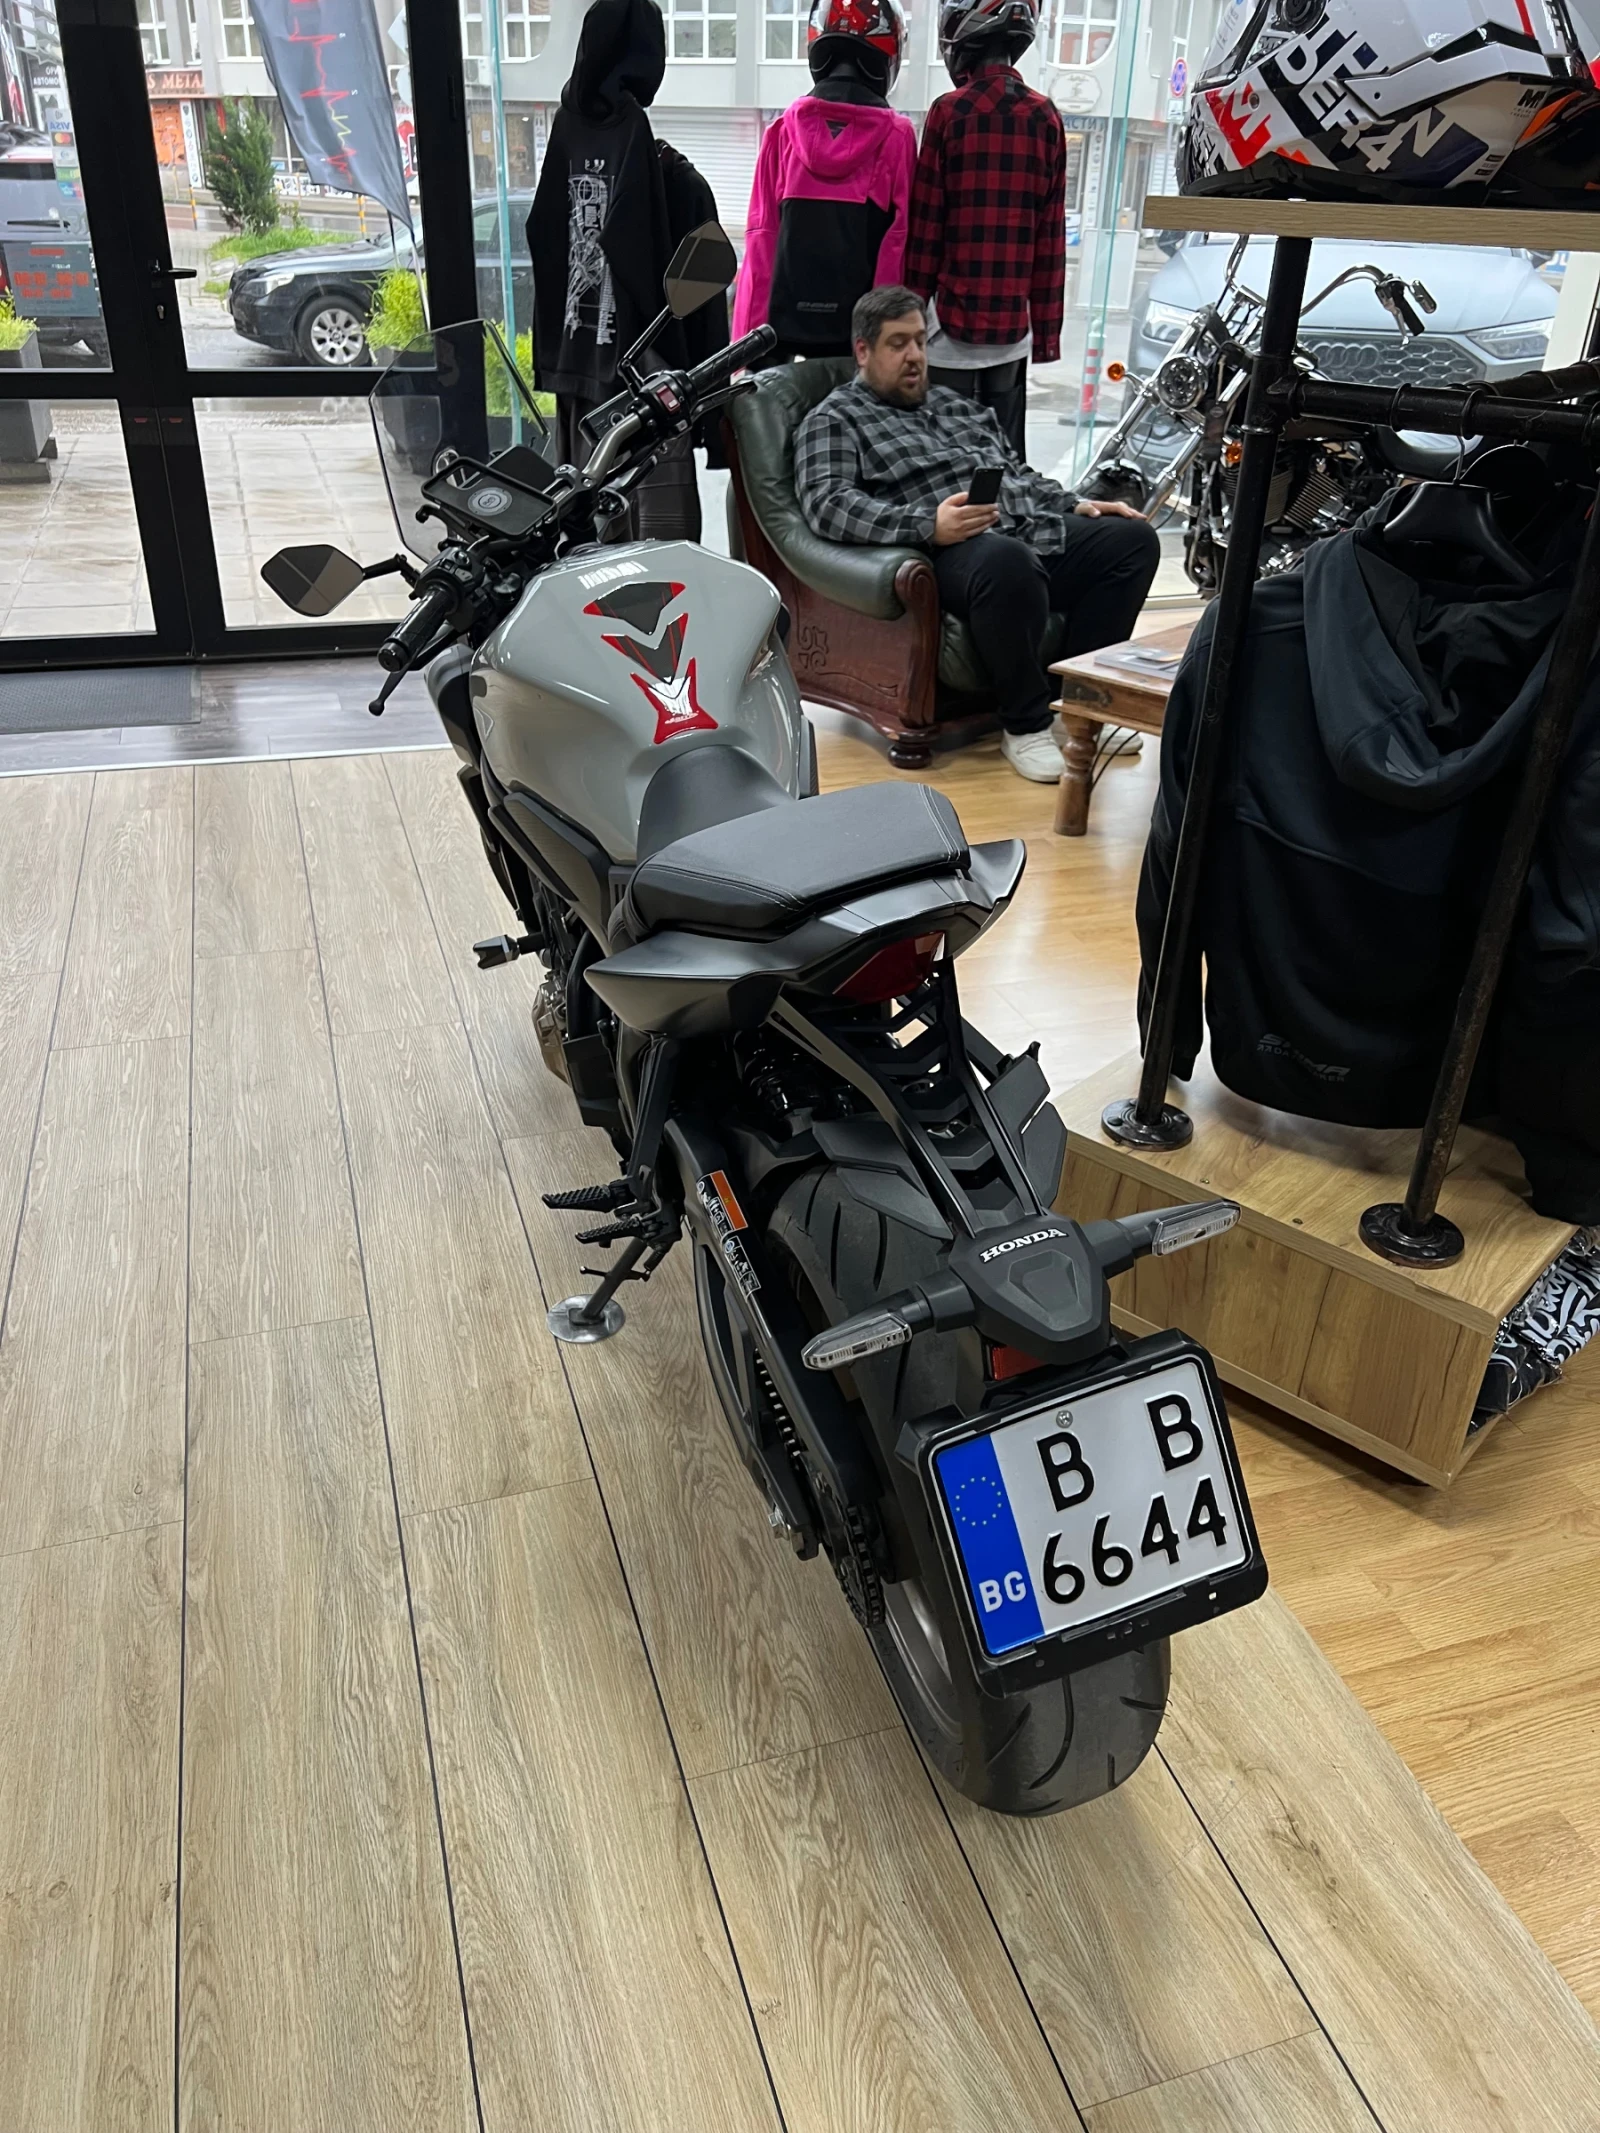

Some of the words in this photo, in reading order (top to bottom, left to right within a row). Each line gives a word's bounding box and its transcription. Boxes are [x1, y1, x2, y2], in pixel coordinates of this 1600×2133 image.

[162, 73, 204, 89] META
[980, 1228, 1067, 1263] HONDA
[1036, 1431, 1095, 1512] B
[1145, 1392, 1204, 1472] B
[1043, 1474, 1228, 1605] 6644
[979, 1570, 1027, 1613] BG
